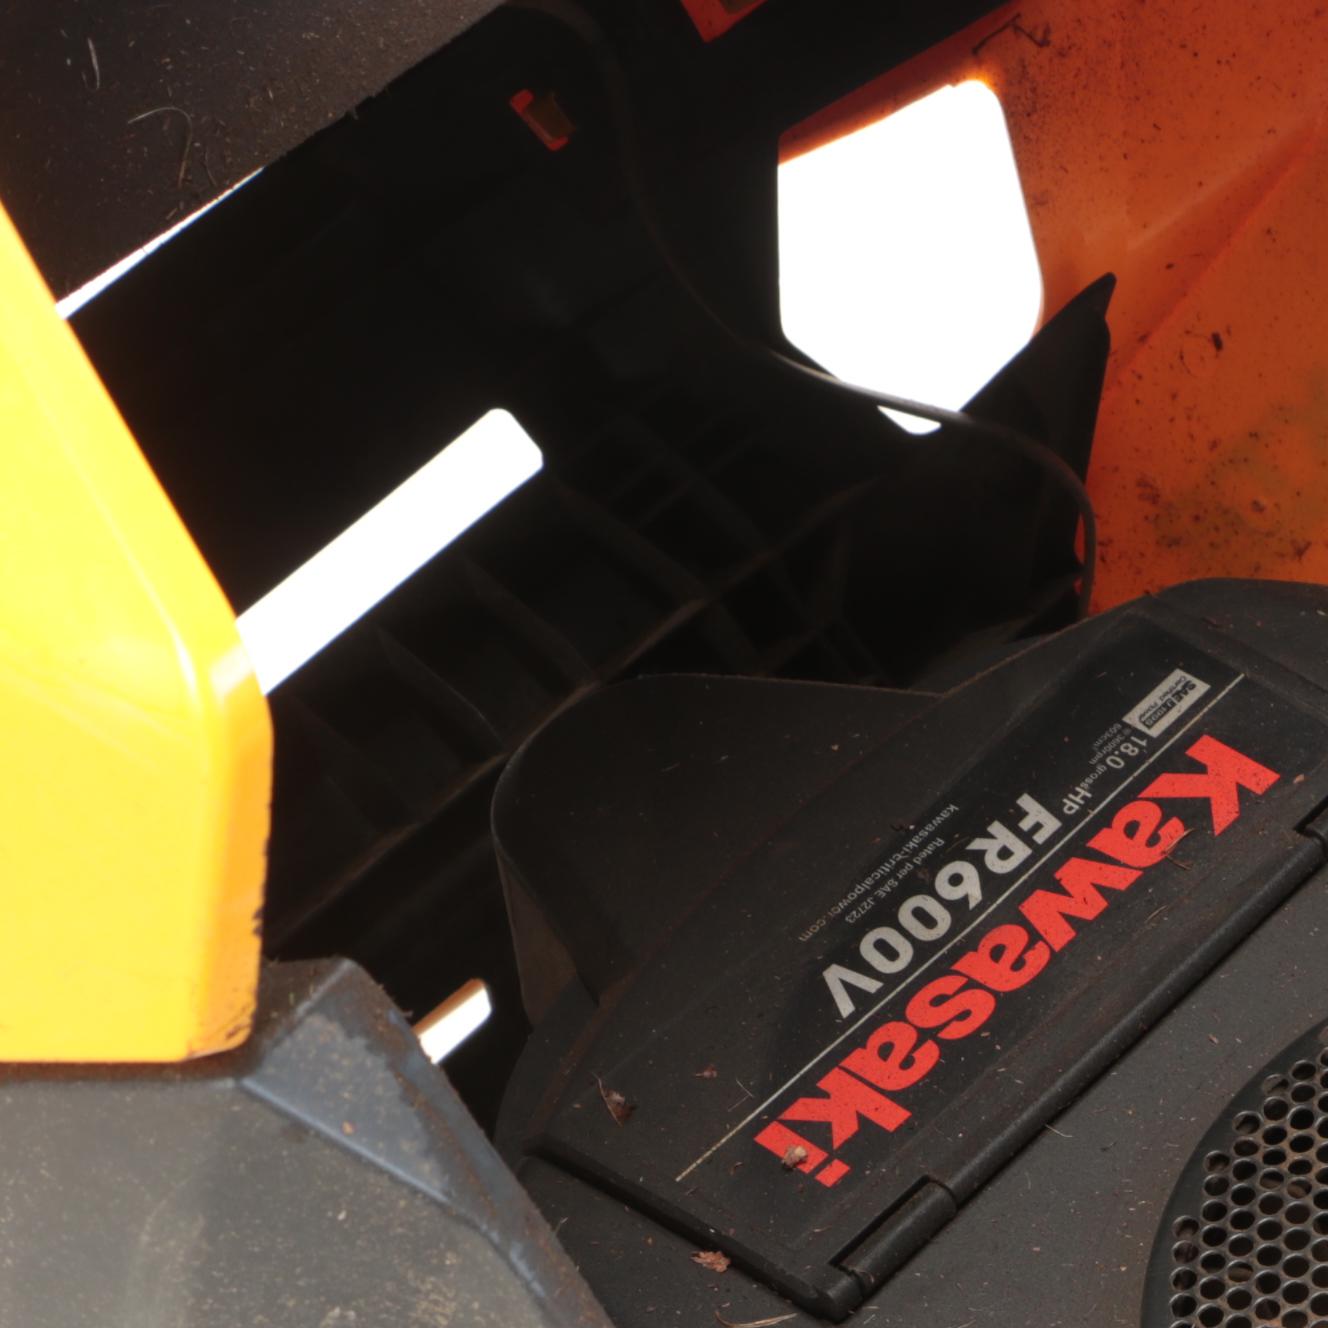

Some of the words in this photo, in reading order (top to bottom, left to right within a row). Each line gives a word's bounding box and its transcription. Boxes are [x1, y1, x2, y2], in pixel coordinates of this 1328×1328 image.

[1170, 679, 1196, 703] SAE
[1104, 731, 1147, 771] 18.0
[911, 835, 945, 866] Rated
[895, 860, 913, 879] per
[873, 876, 898, 899] SAE
[817, 790, 1062, 1019] FR600V
[754, 735, 1282, 1187] Kawasaki
